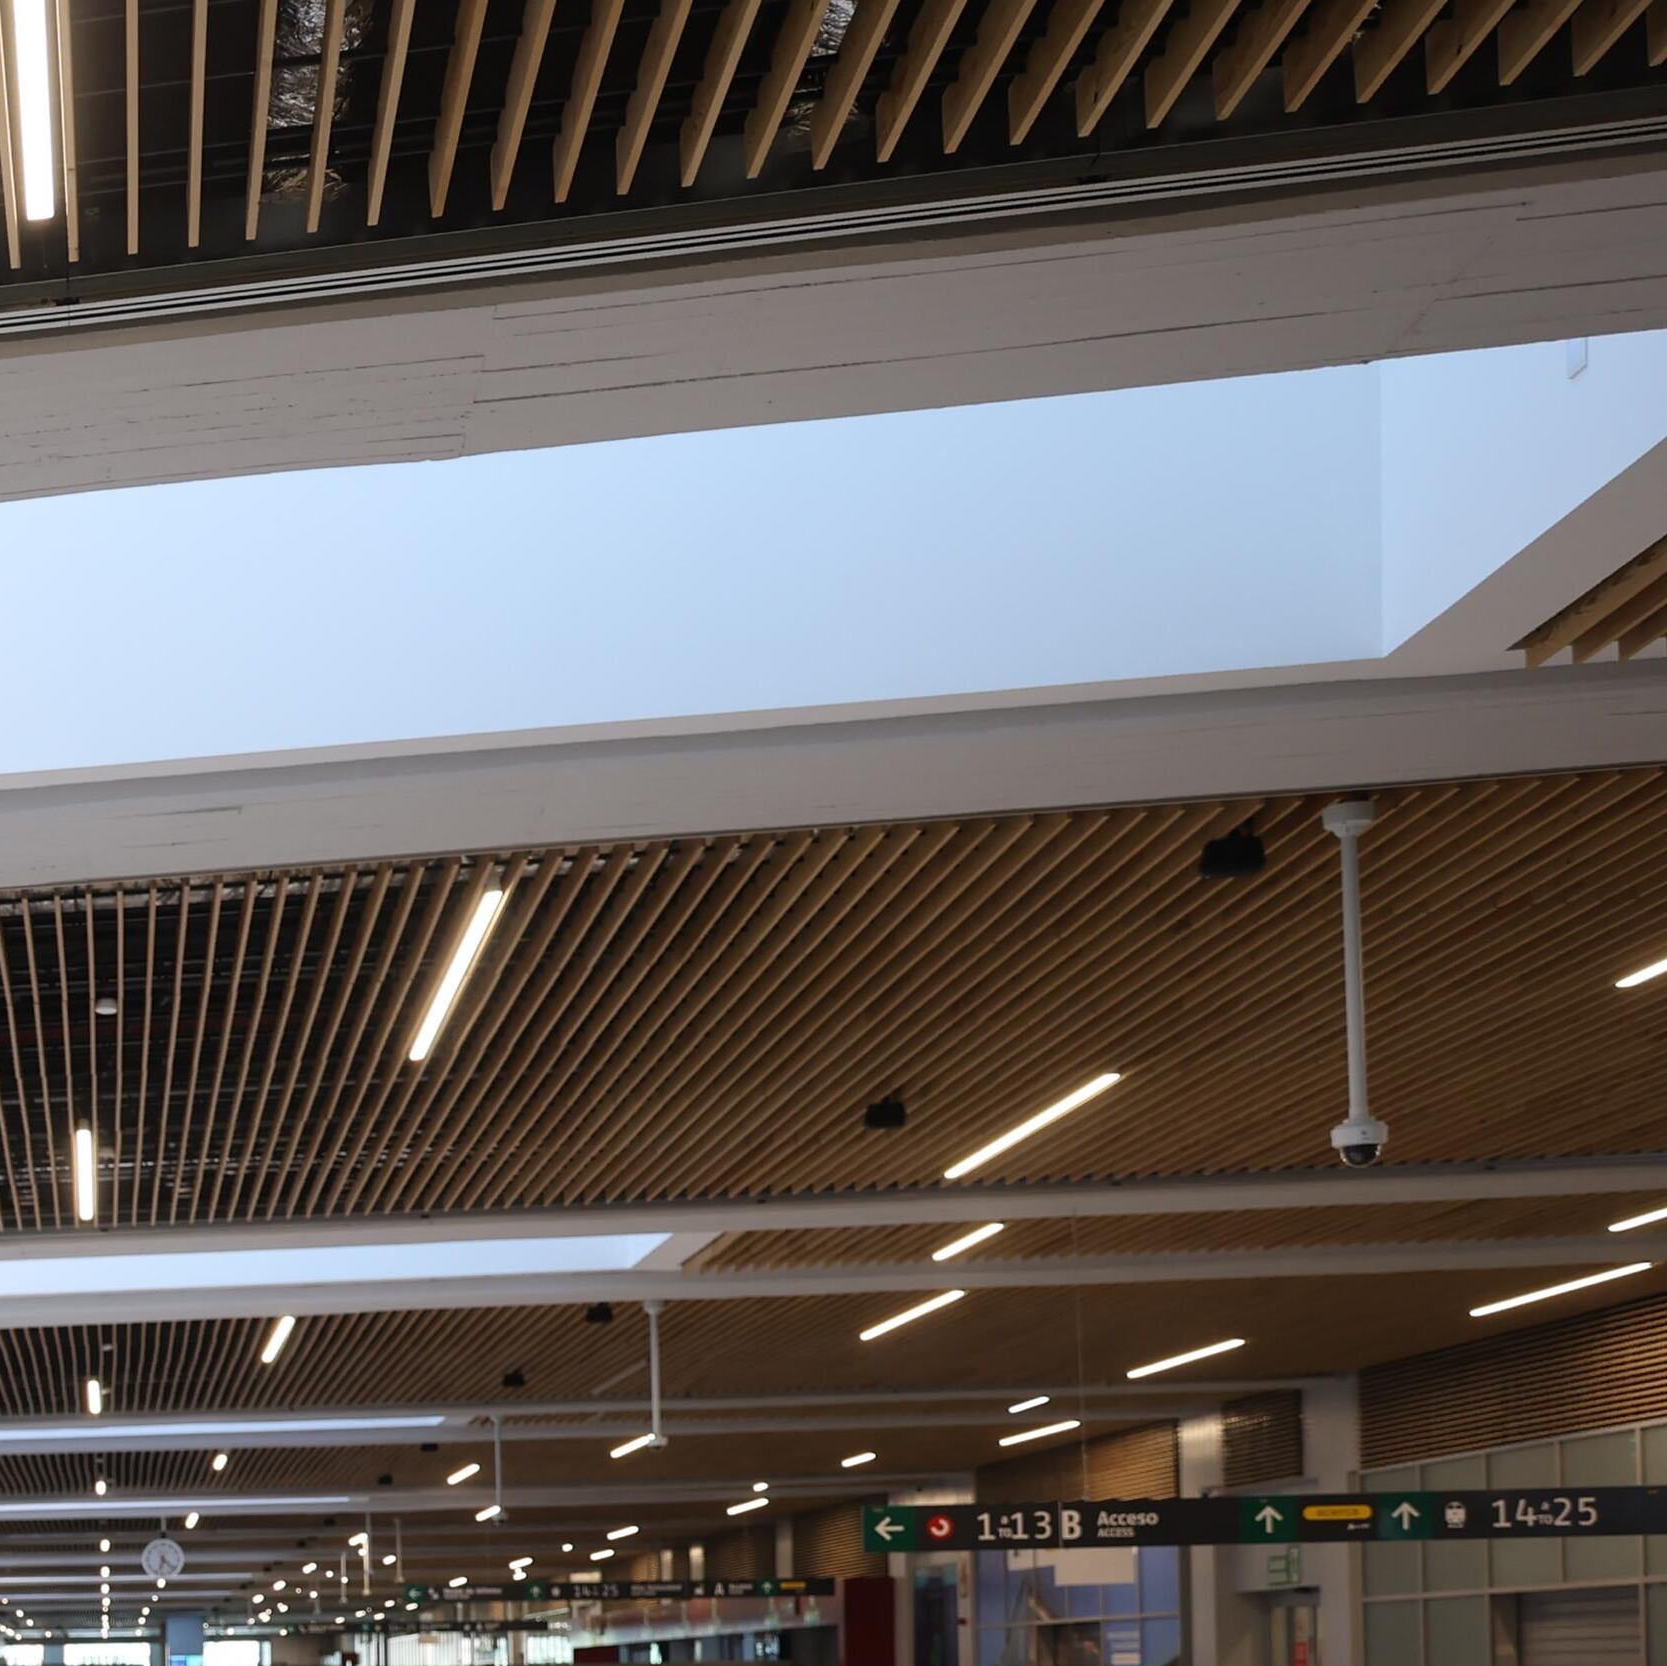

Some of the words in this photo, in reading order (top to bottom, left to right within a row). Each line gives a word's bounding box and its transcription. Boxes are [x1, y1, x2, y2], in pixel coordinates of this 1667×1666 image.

[1012, 1510, 1052, 1540] 13
[1061, 1509, 1082, 1540] B
[1097, 1510, 1159, 1527] Acceso
[1491, 1499, 1537, 1529] 14
[1553, 1497, 1598, 1526] 25
[1097, 1527, 1134, 1538] ACCESS
